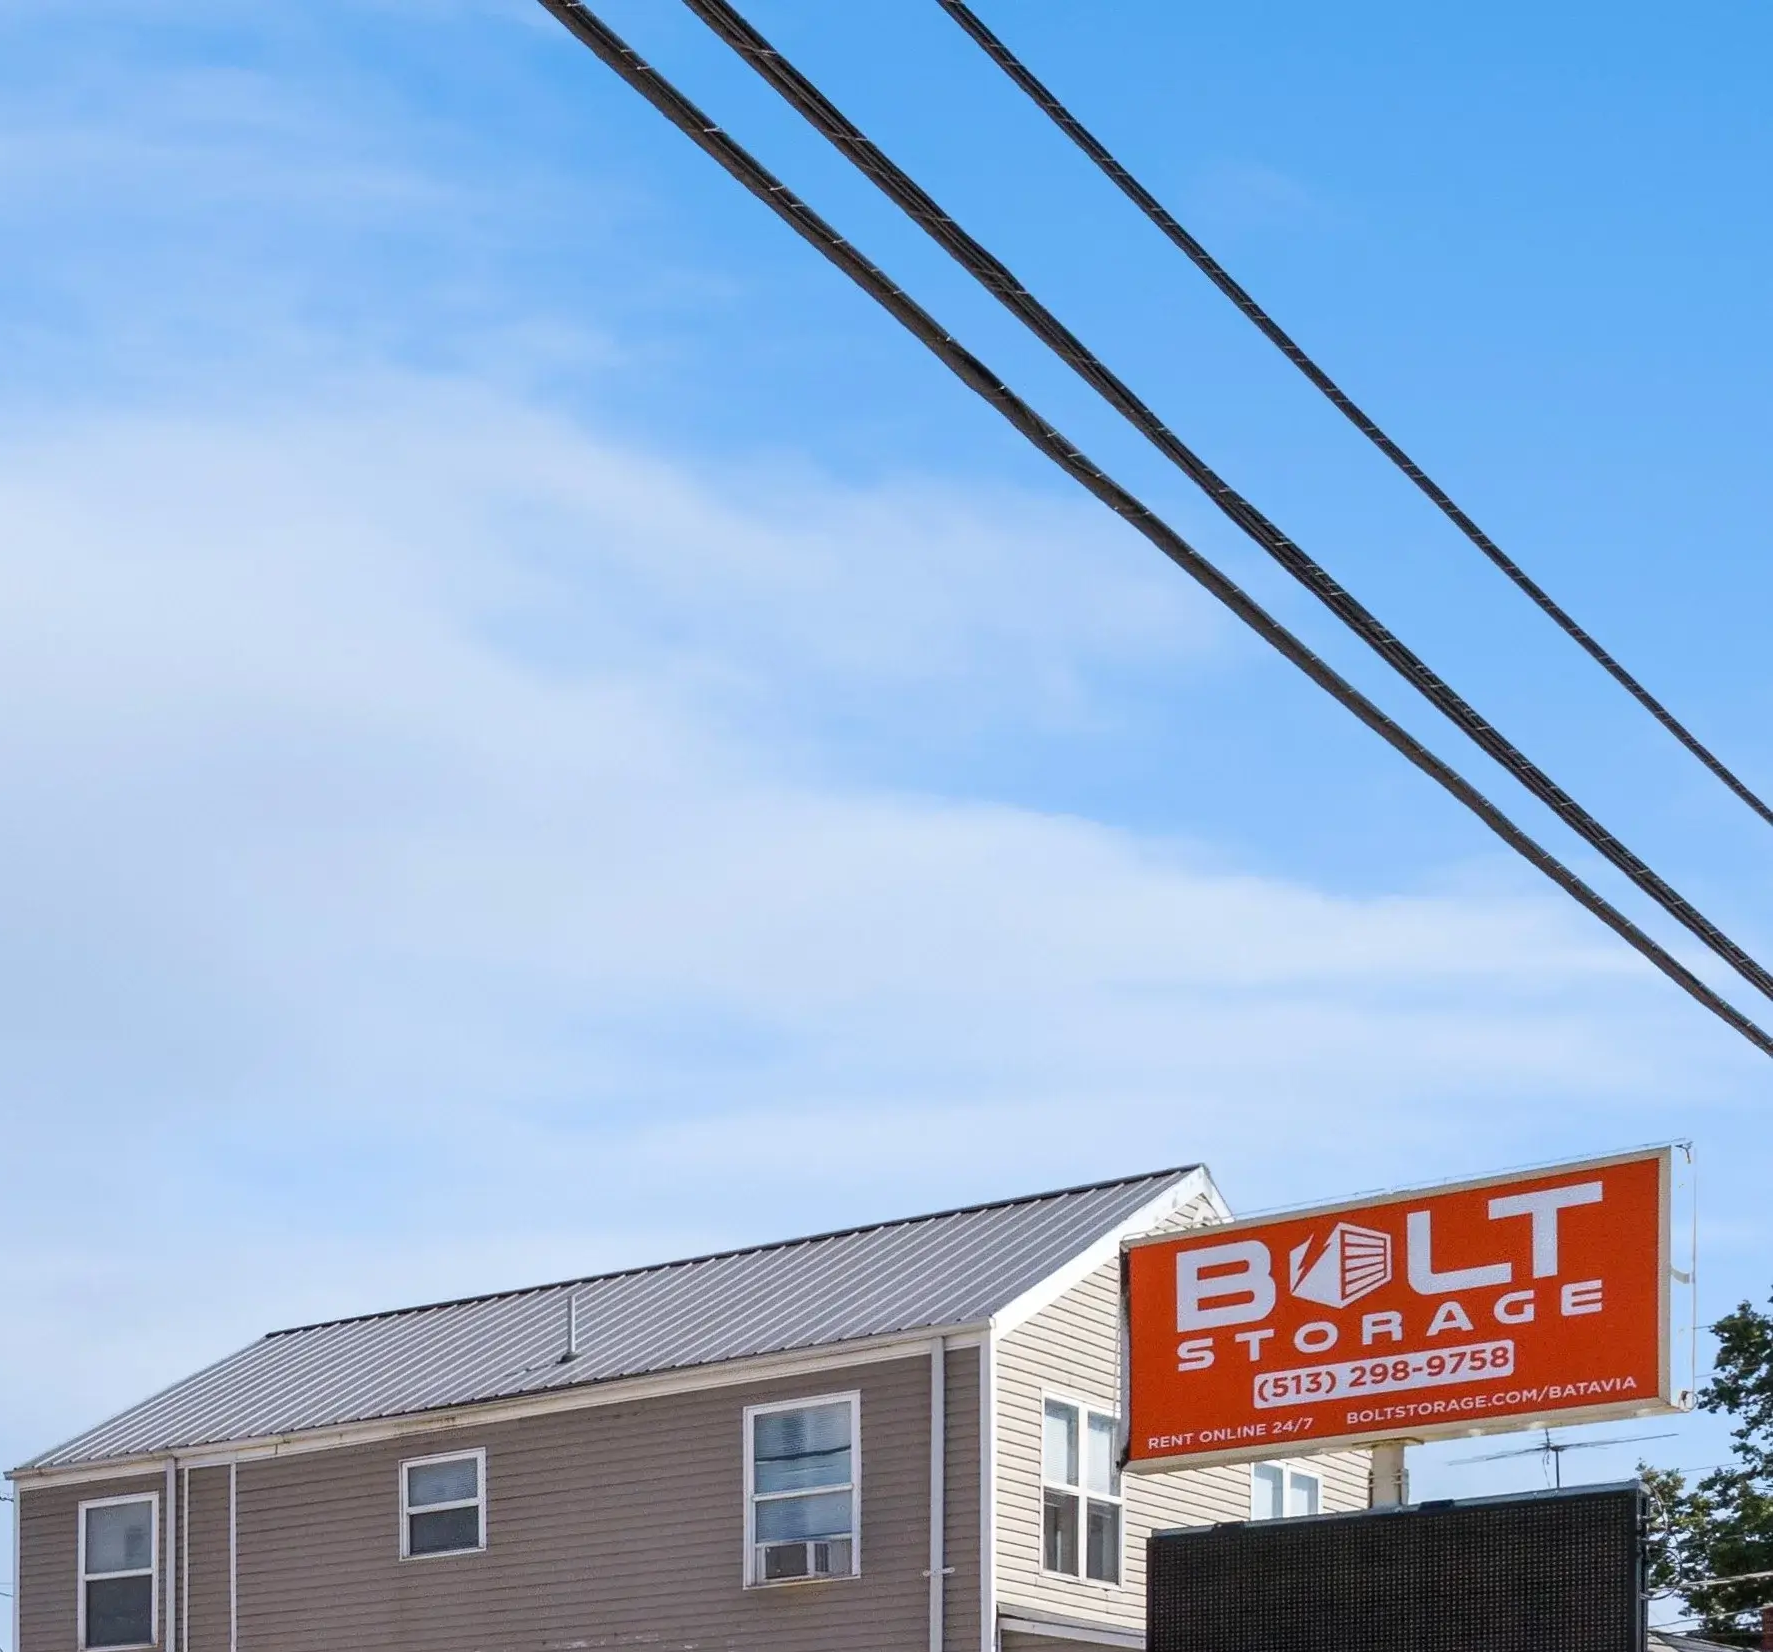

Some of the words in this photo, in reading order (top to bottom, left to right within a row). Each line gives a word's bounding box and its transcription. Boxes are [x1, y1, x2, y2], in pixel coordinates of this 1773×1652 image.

[1176, 1180, 1603, 1333] BOLT
[1176, 1278, 1603, 1372] STORAGE
[1257, 1370, 1337, 1403] (513)
[1349, 1346, 1510, 1388] 298-9758
[1347, 1375, 1637, 1425] BOLTSTORAGE.COM/BATAVIA
[1148, 1432, 1194, 1450] RENT
[1199, 1423, 1266, 1443] ONLINE
[1273, 1417, 1314, 1433] 24/7
